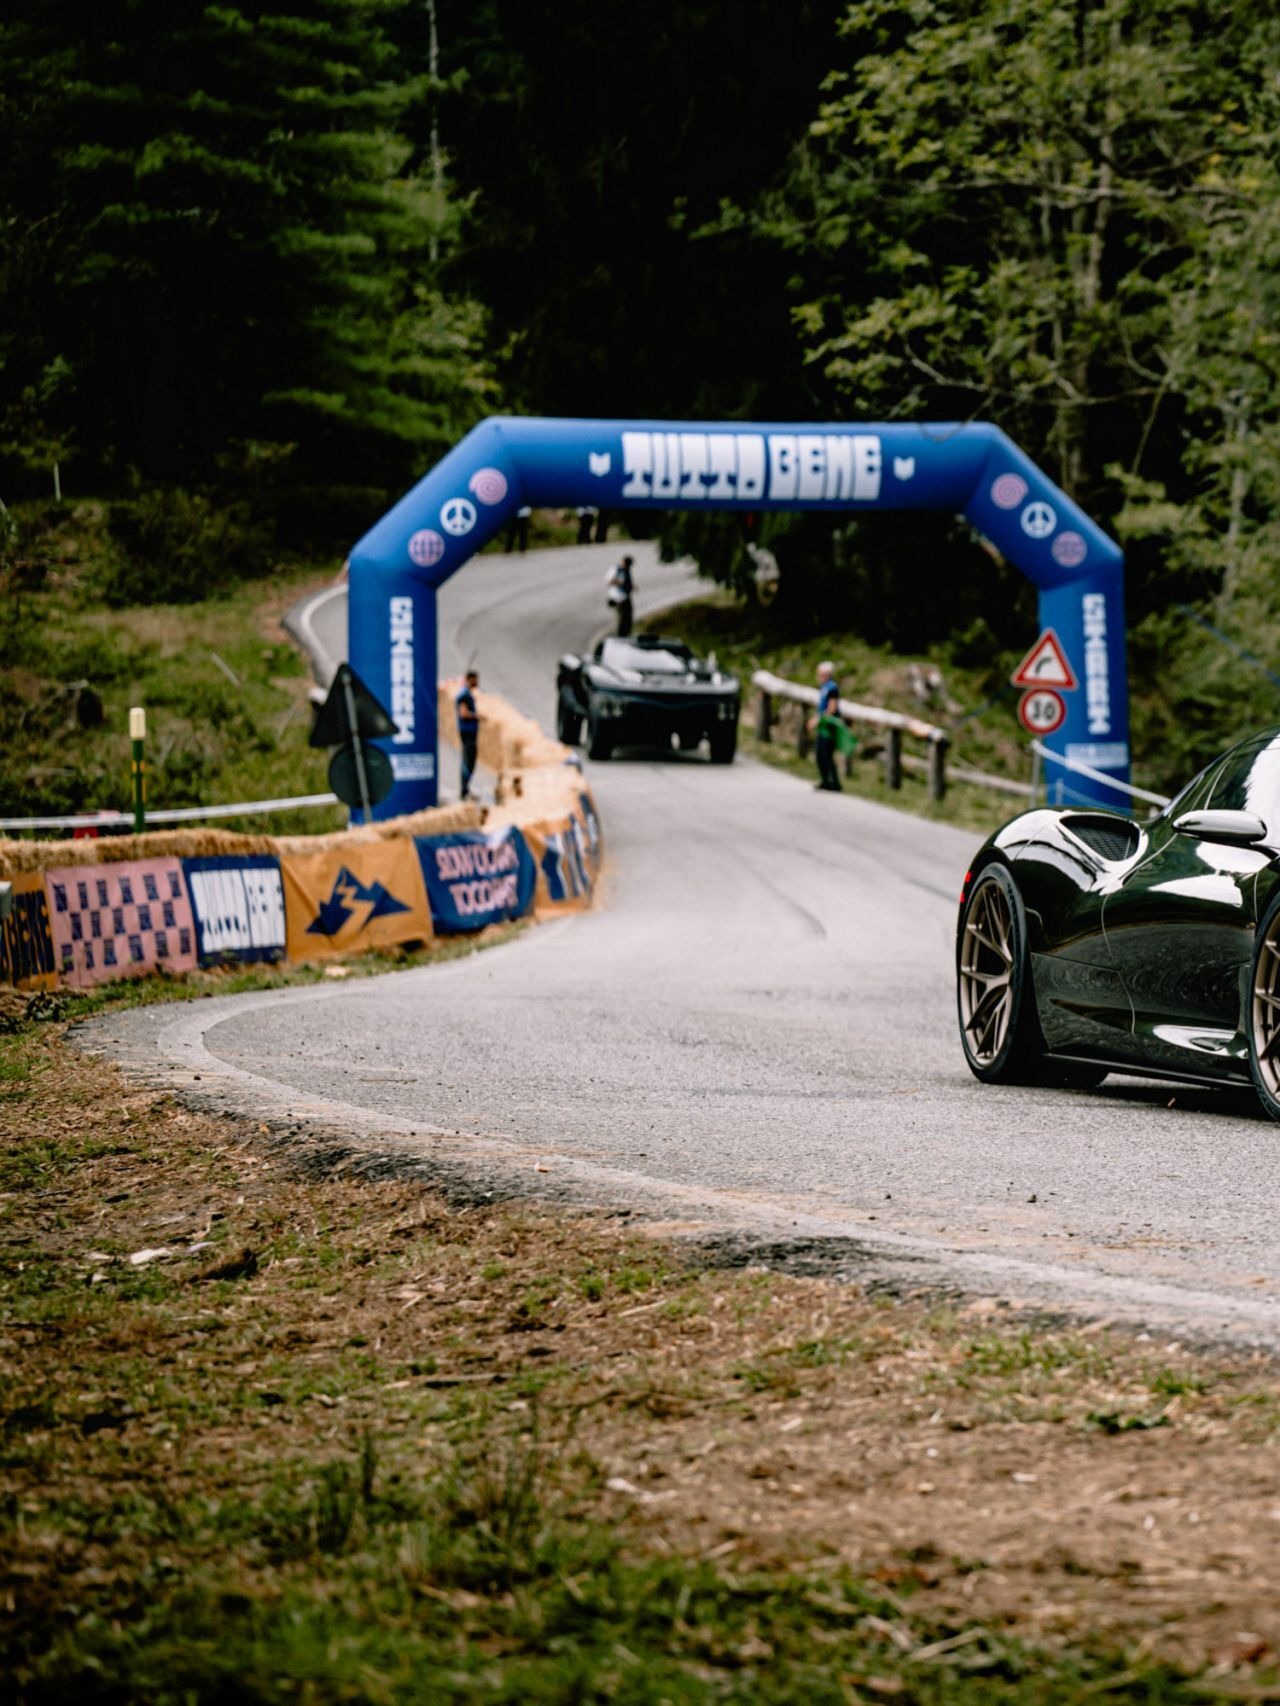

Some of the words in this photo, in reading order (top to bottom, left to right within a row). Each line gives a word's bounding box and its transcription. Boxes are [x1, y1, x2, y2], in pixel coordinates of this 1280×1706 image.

[621, 432, 766, 499] TUTTO
[767, 434, 882, 500] BENE
[1029, 699, 1056, 721] 30
